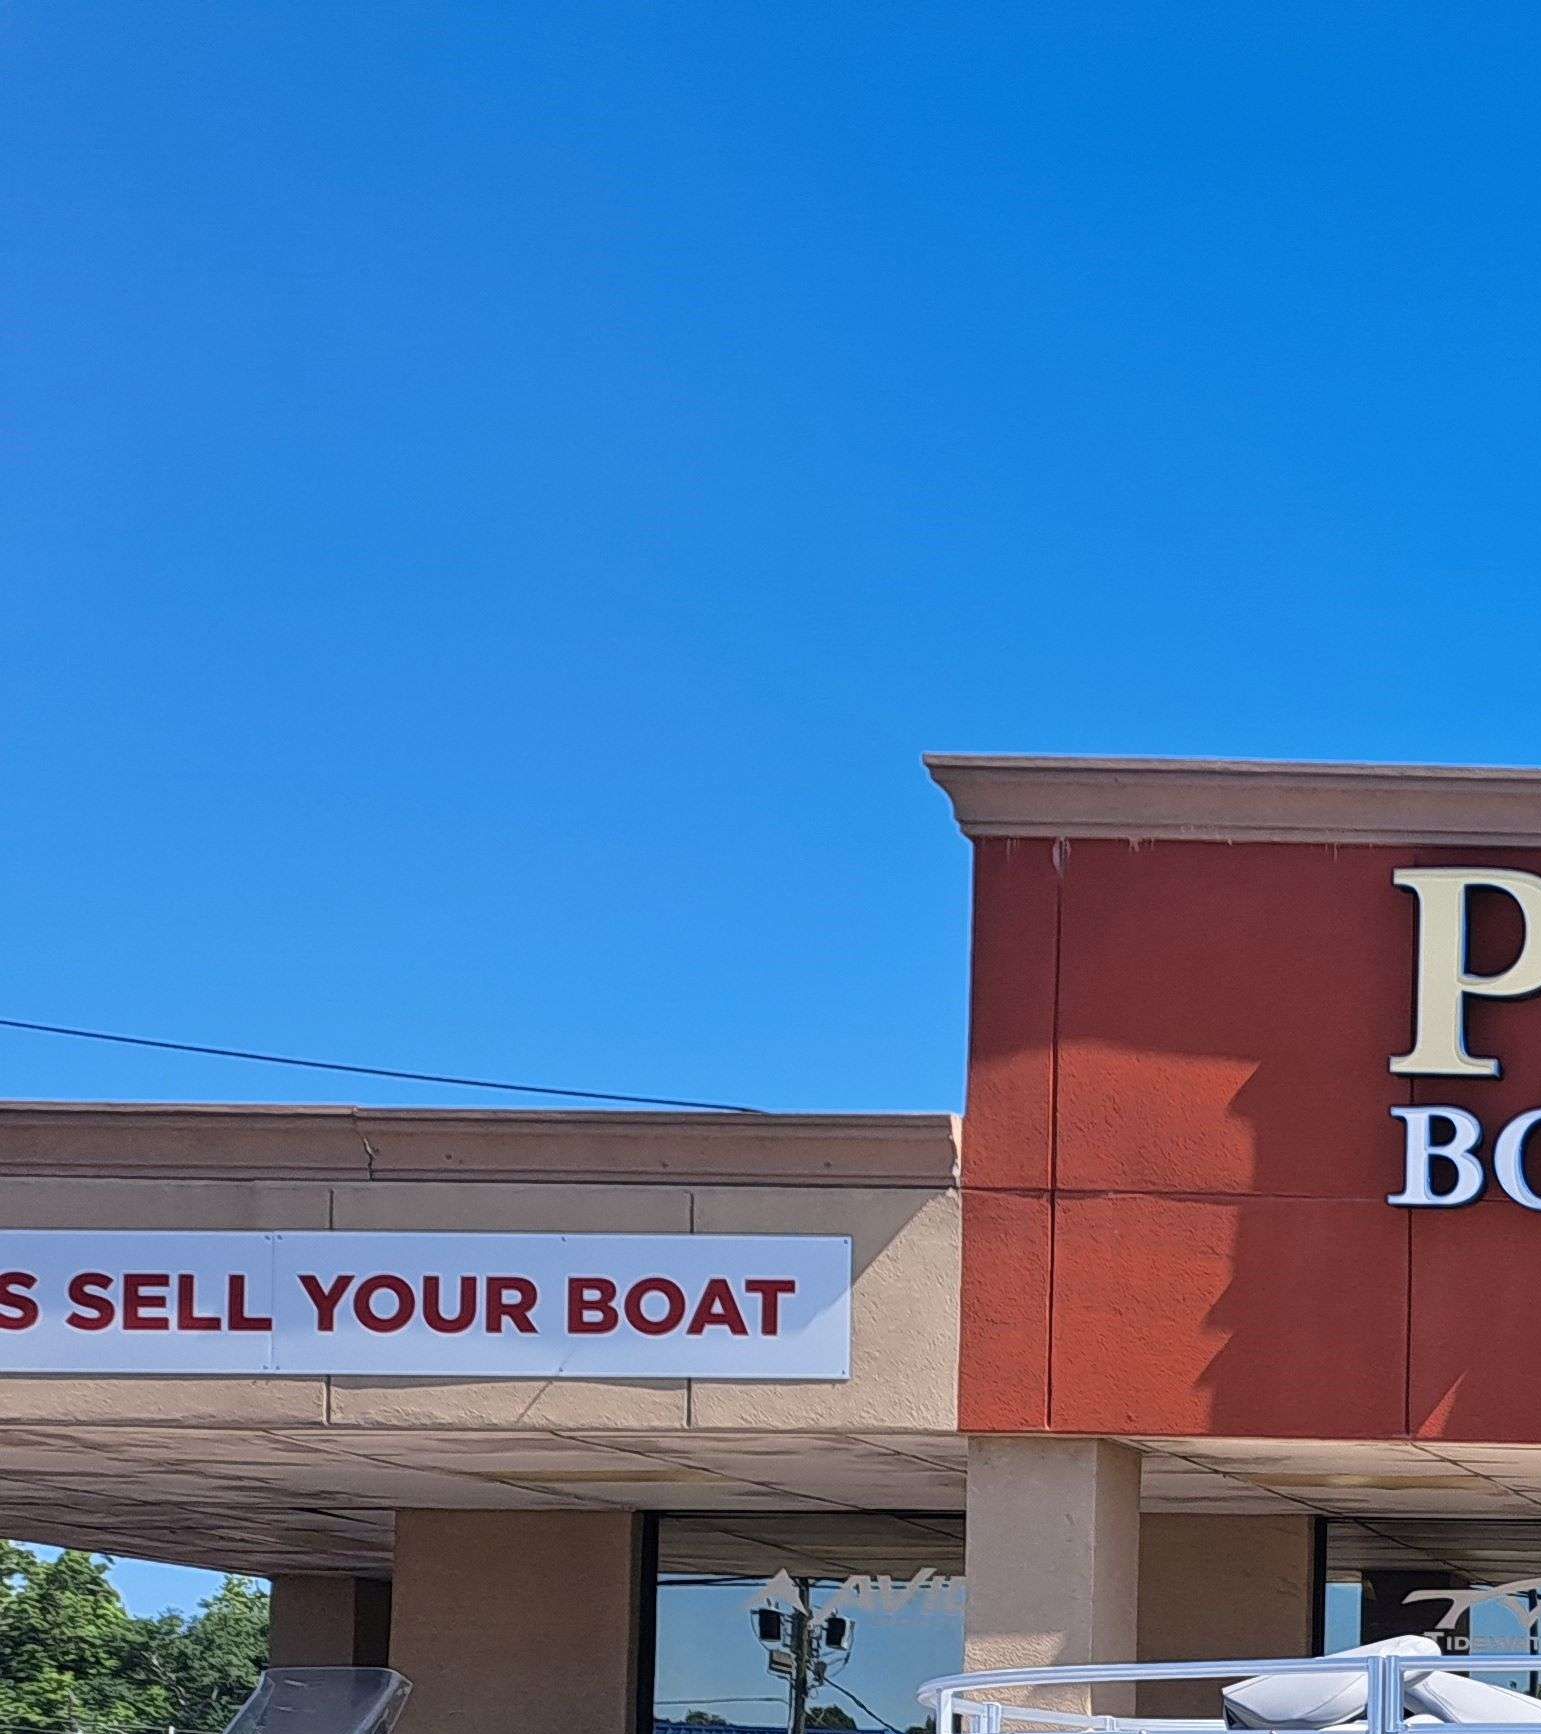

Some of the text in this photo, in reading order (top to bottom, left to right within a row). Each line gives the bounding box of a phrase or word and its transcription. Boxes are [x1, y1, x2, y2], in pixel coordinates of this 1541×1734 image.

[67, 1273, 272, 1332] SELL
[299, 1275, 539, 1335] YOUR
[566, 1277, 796, 1337] BOAT
